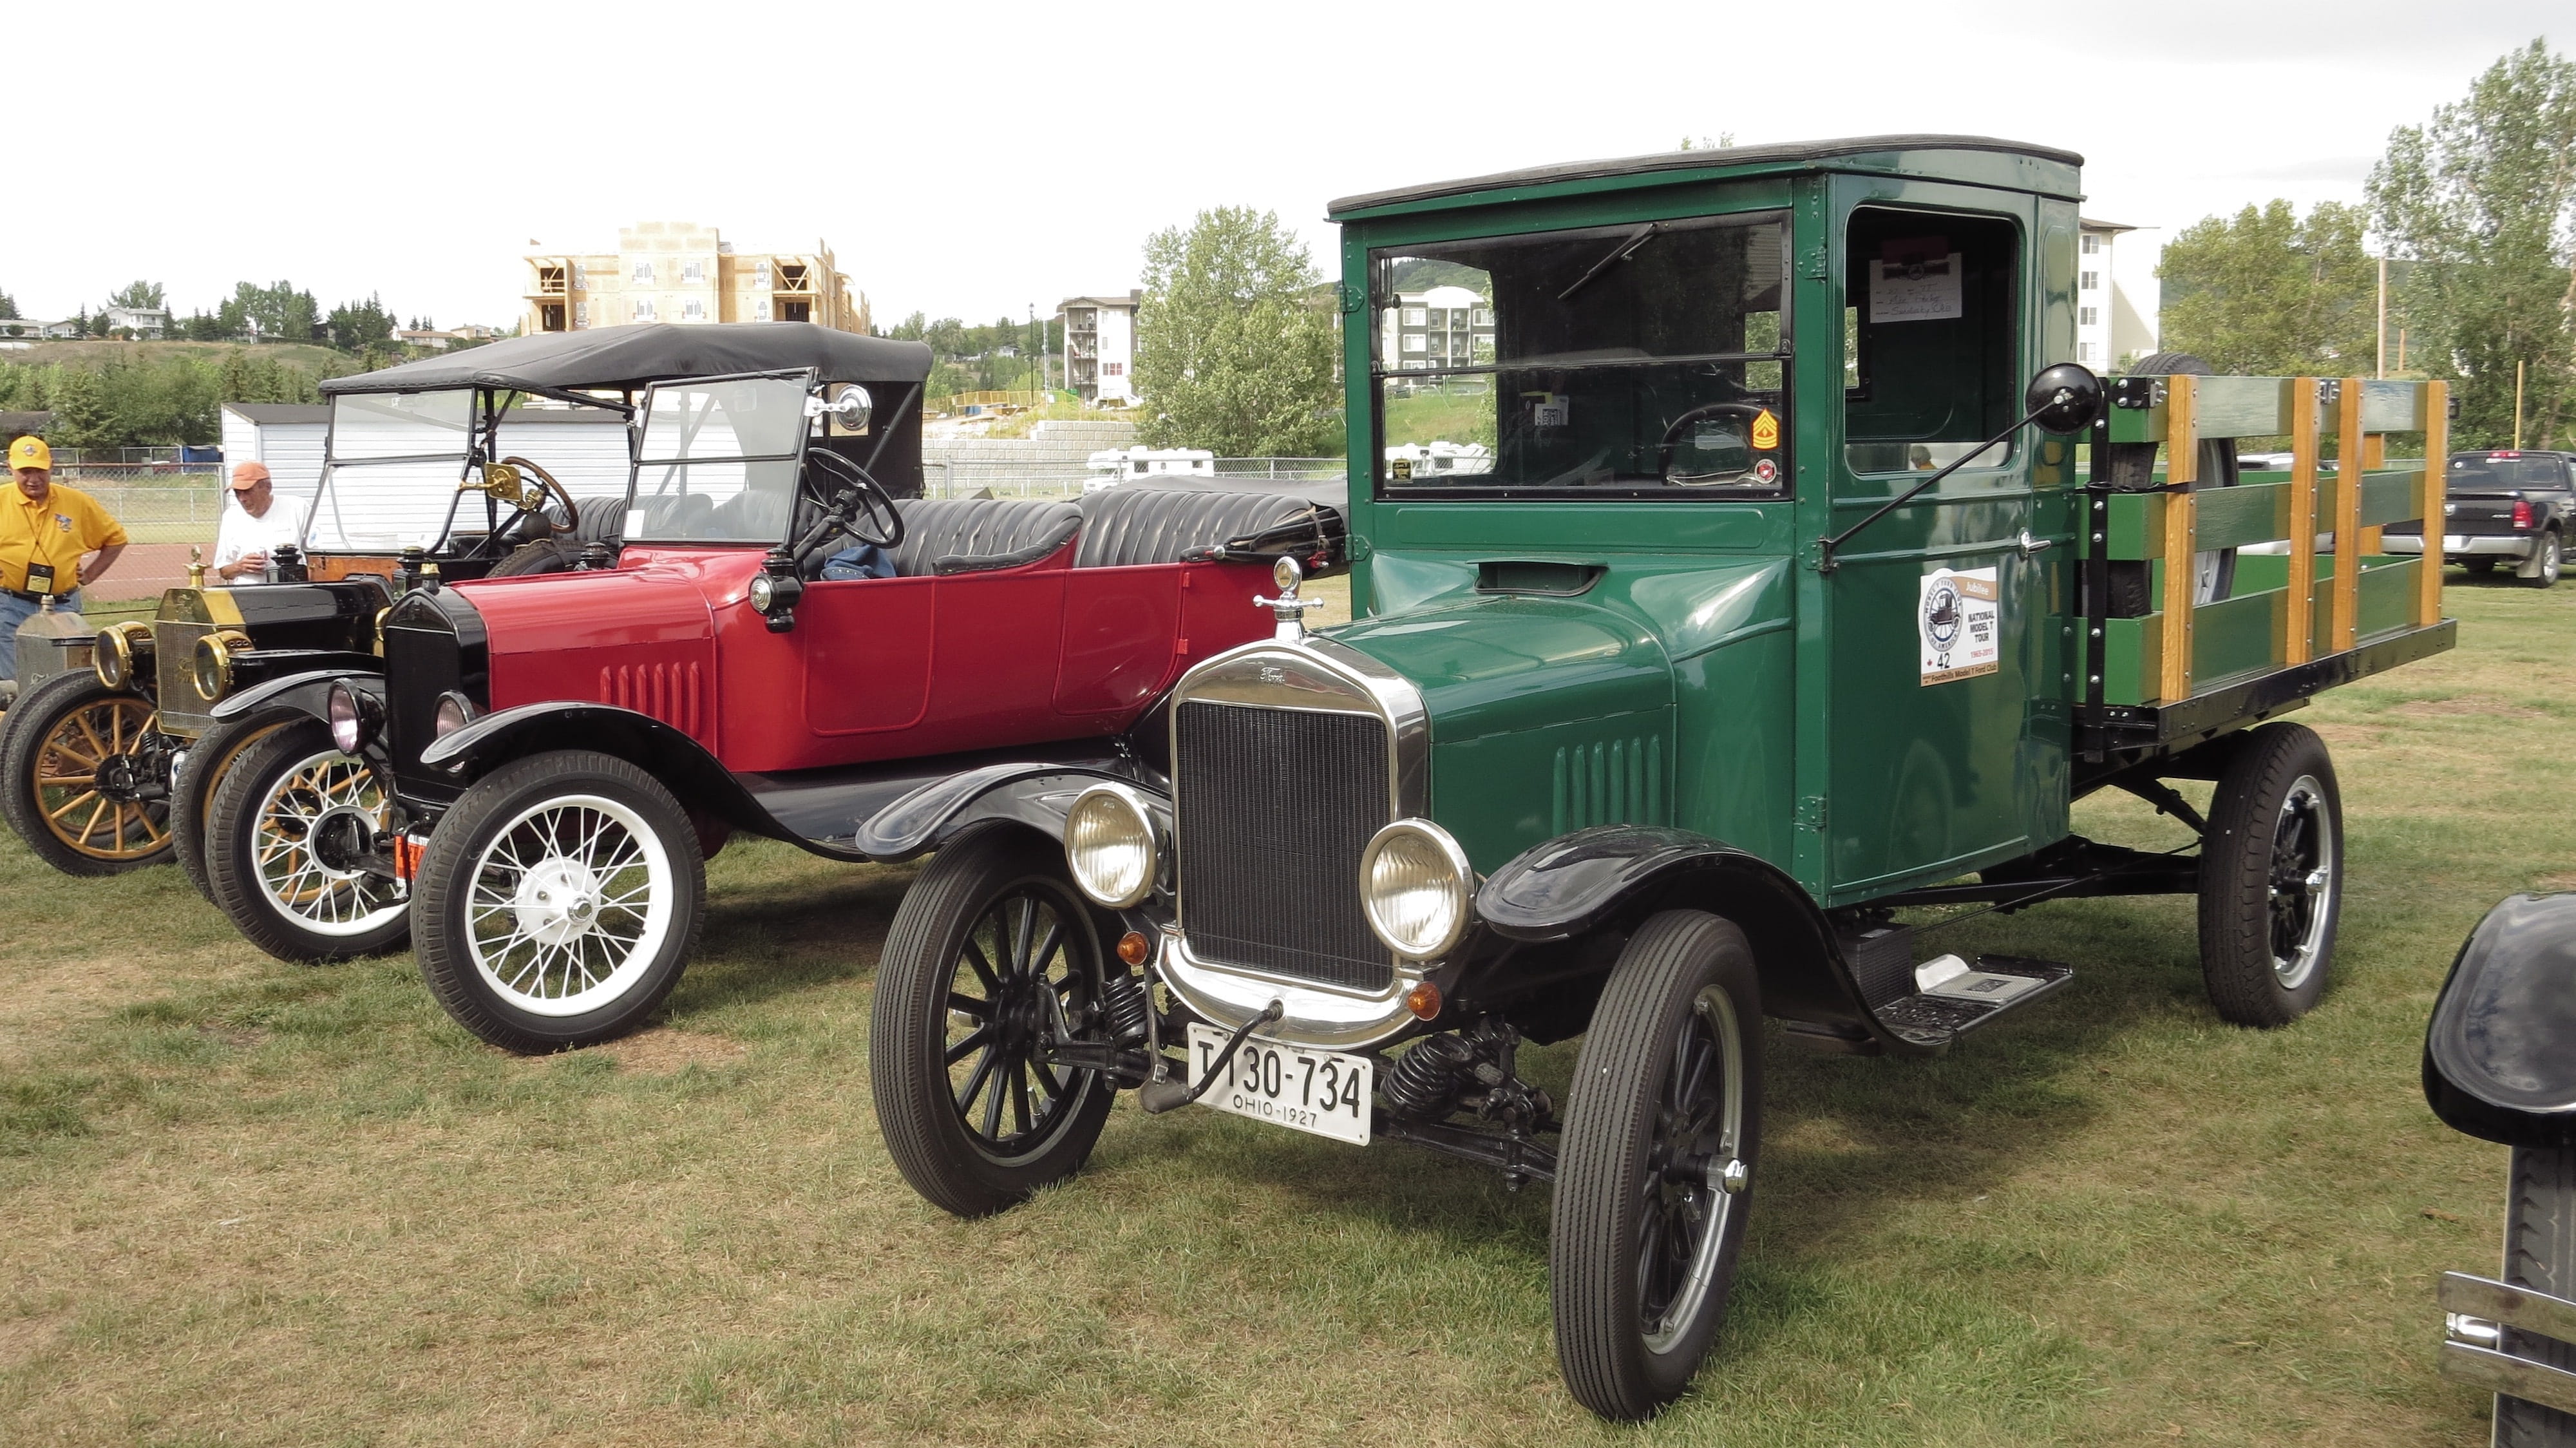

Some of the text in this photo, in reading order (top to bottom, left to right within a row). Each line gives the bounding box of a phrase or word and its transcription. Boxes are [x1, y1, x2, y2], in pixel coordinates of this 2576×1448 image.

[1966, 582, 1989, 595] Jubilee
[1968, 611, 1994, 622] NATIONAL
[1969, 624, 1989, 633] MODEL
[1975, 633, 1989, 643] TOUR
[1937, 653, 1950, 669] 42
[1260, 667, 1285, 683] Ford
[1931, 672, 1954, 682] Foothills
[1955, 668, 1971, 678] Model
[1975, 666, 1985, 674] Ford
